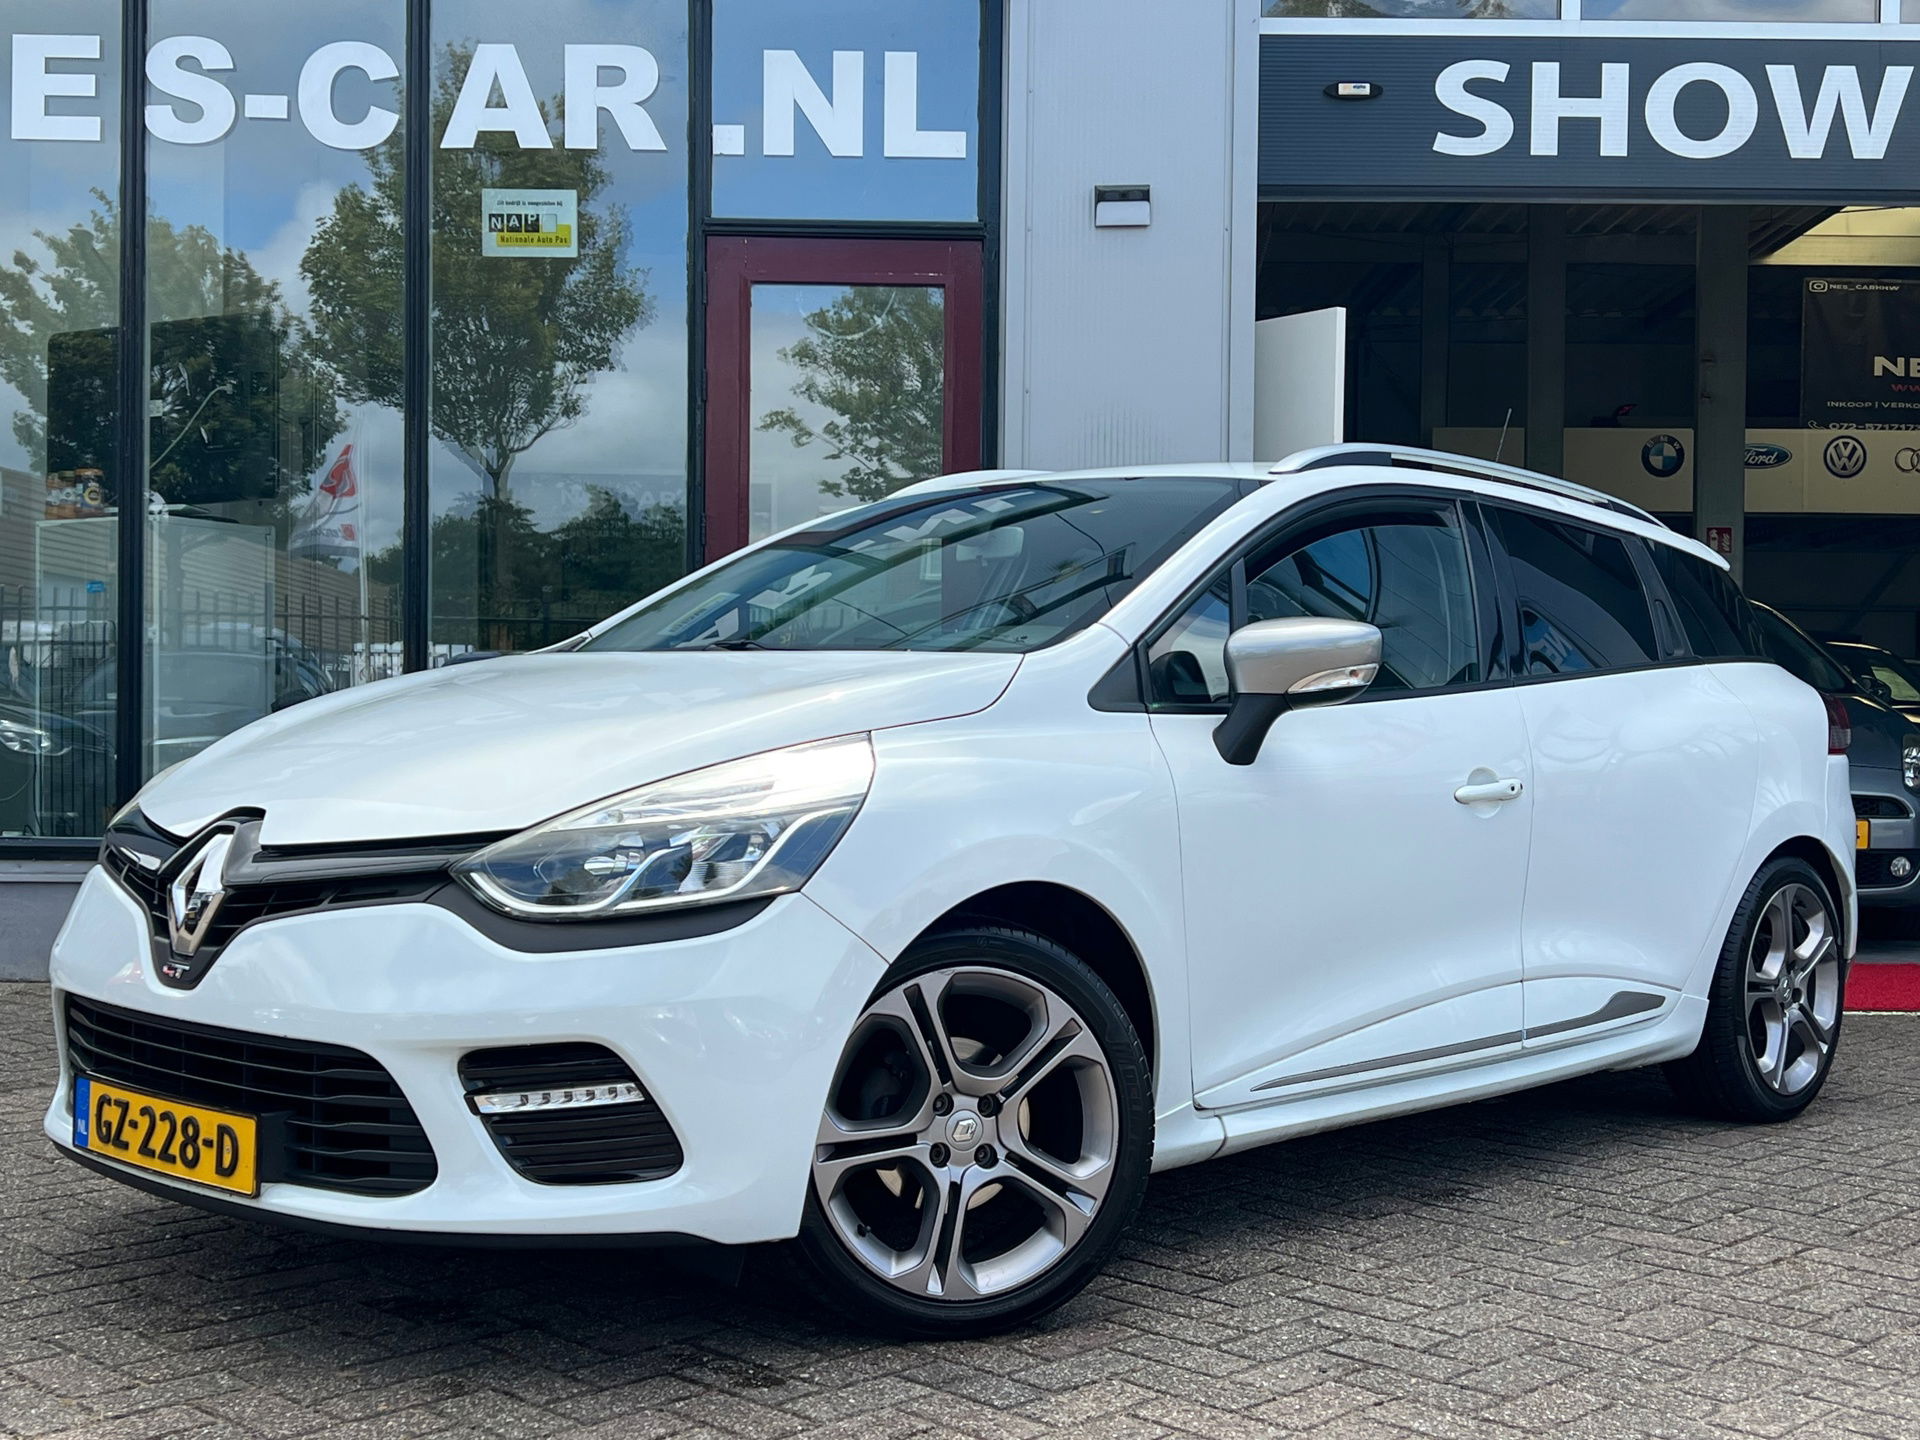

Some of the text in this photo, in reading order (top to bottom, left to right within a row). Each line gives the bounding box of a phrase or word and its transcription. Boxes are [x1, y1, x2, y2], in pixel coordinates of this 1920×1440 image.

[1433, 58, 1915, 160] SHOW
[491, 213, 537, 230] NAP
[500, 236, 534, 244] Nationale
[537, 236, 553, 244] Auto
[77, 1093, 239, 1178] NL GZ-228-D
